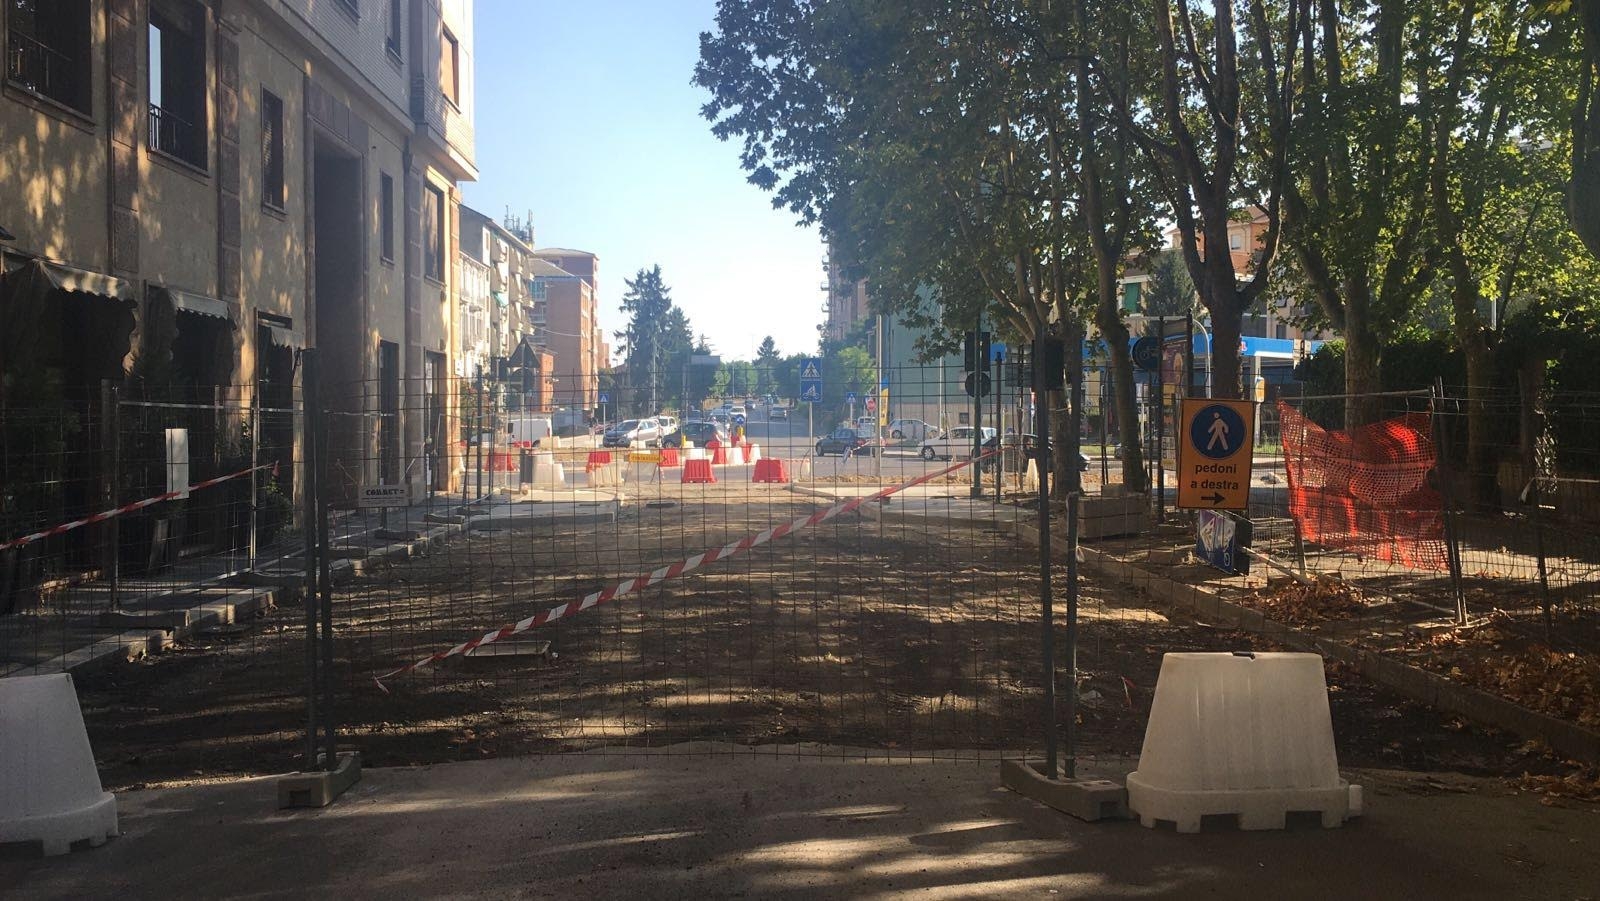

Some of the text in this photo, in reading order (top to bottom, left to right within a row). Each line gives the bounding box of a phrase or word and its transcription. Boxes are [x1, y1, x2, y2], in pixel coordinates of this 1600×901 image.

[1195, 463, 1237, 475] pedoni
[1190, 479, 1239, 490] a destra
